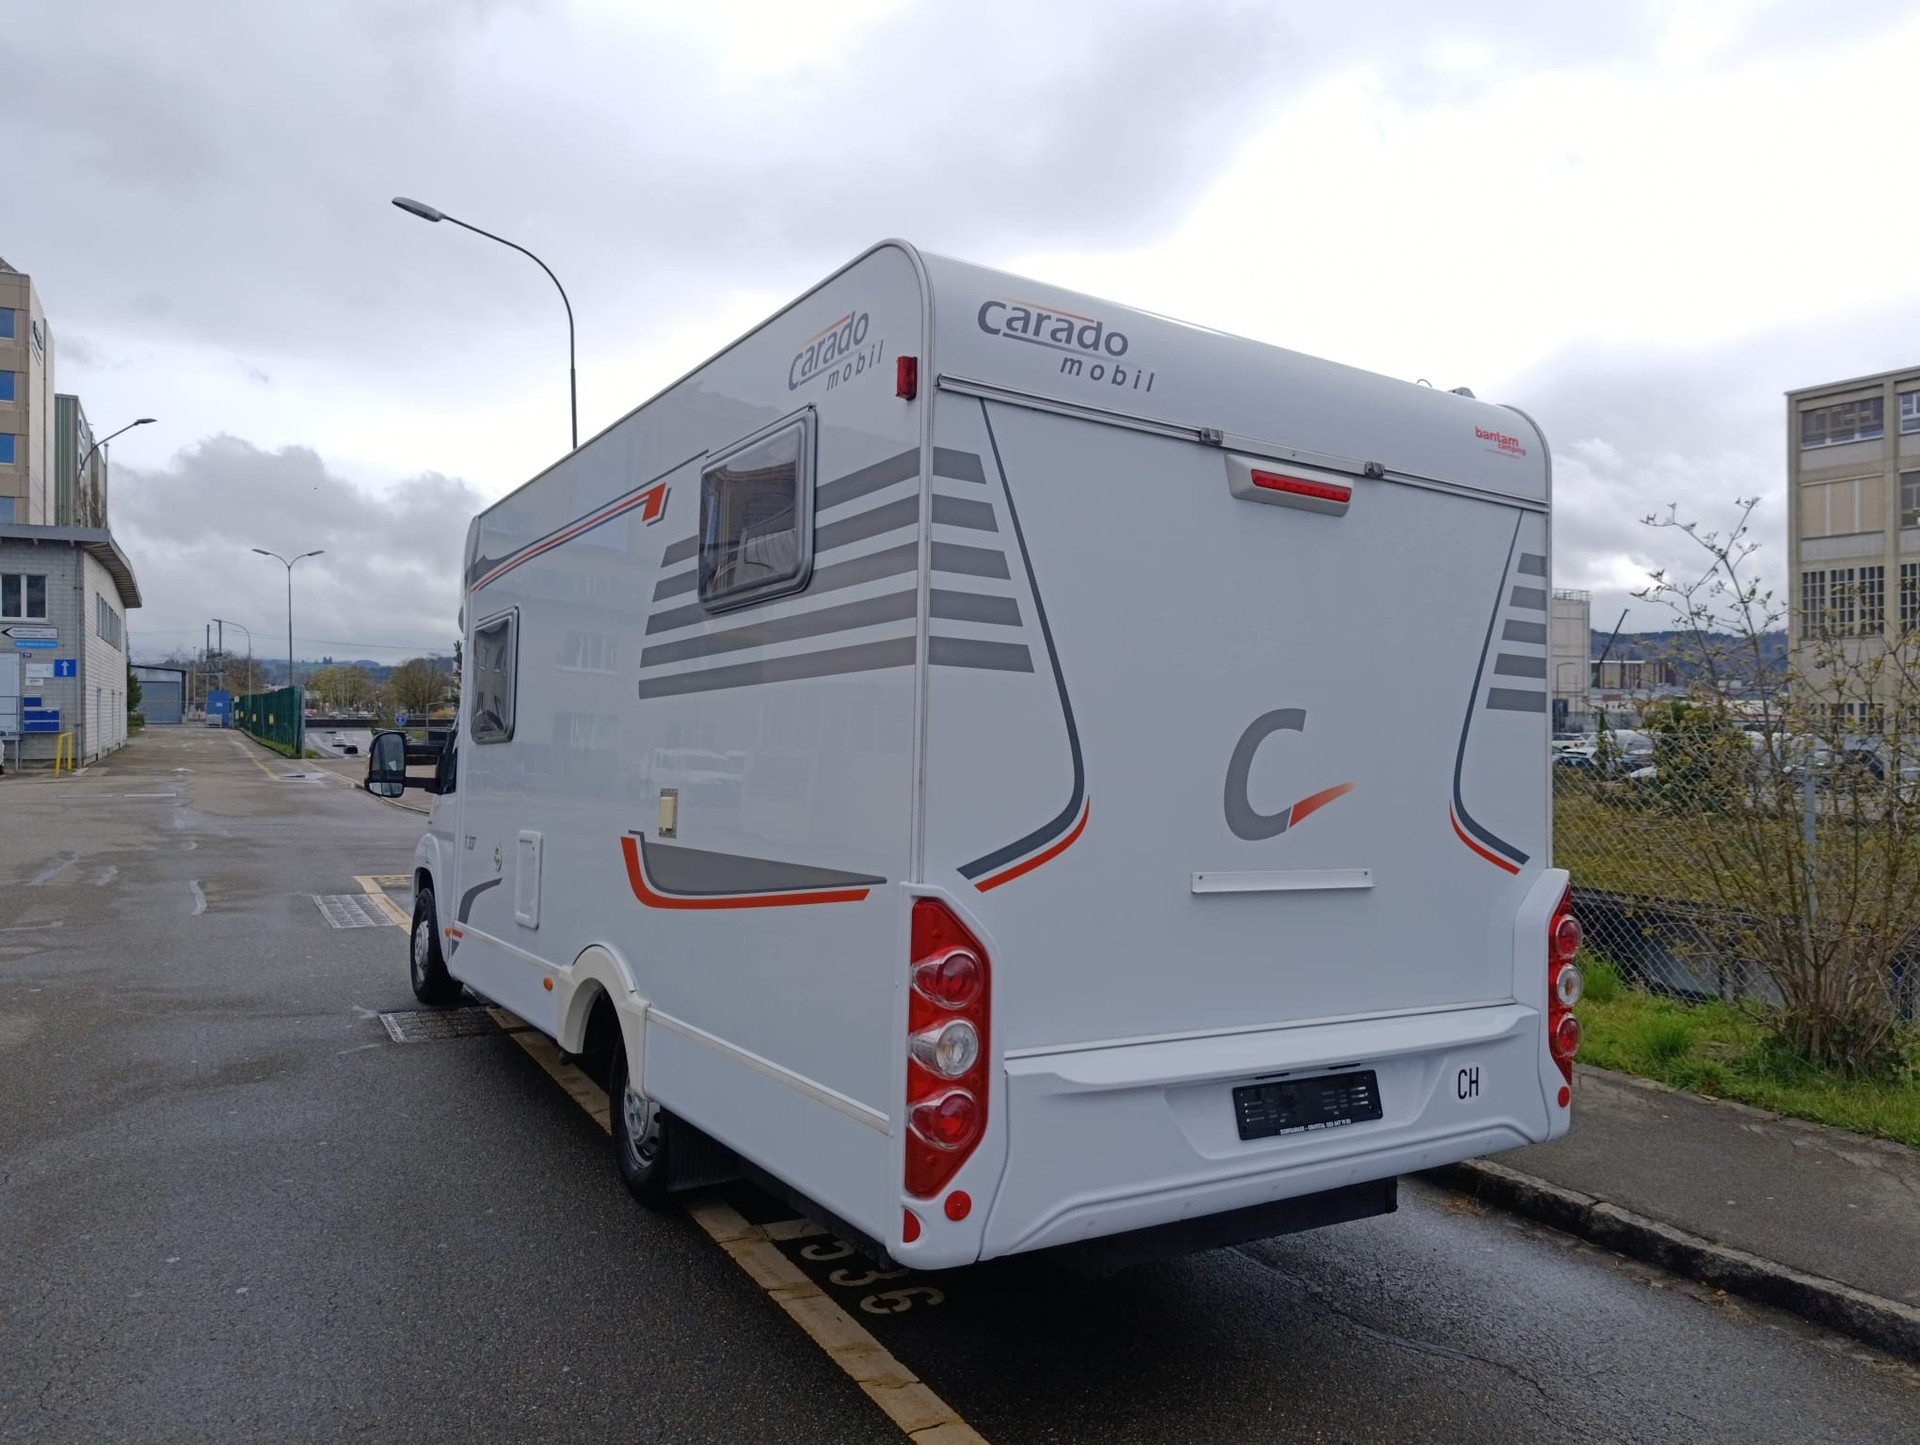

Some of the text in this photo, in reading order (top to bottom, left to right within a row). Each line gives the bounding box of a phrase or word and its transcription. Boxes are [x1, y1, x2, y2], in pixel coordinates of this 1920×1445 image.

[788, 310, 869, 391] Carado
[978, 300, 1129, 357] Carado
[826, 339, 884, 391] mobil
[1060, 356, 1155, 393] mobil
[1475, 425, 1519, 447] bantam
[1457, 1066, 1479, 1100] CH
